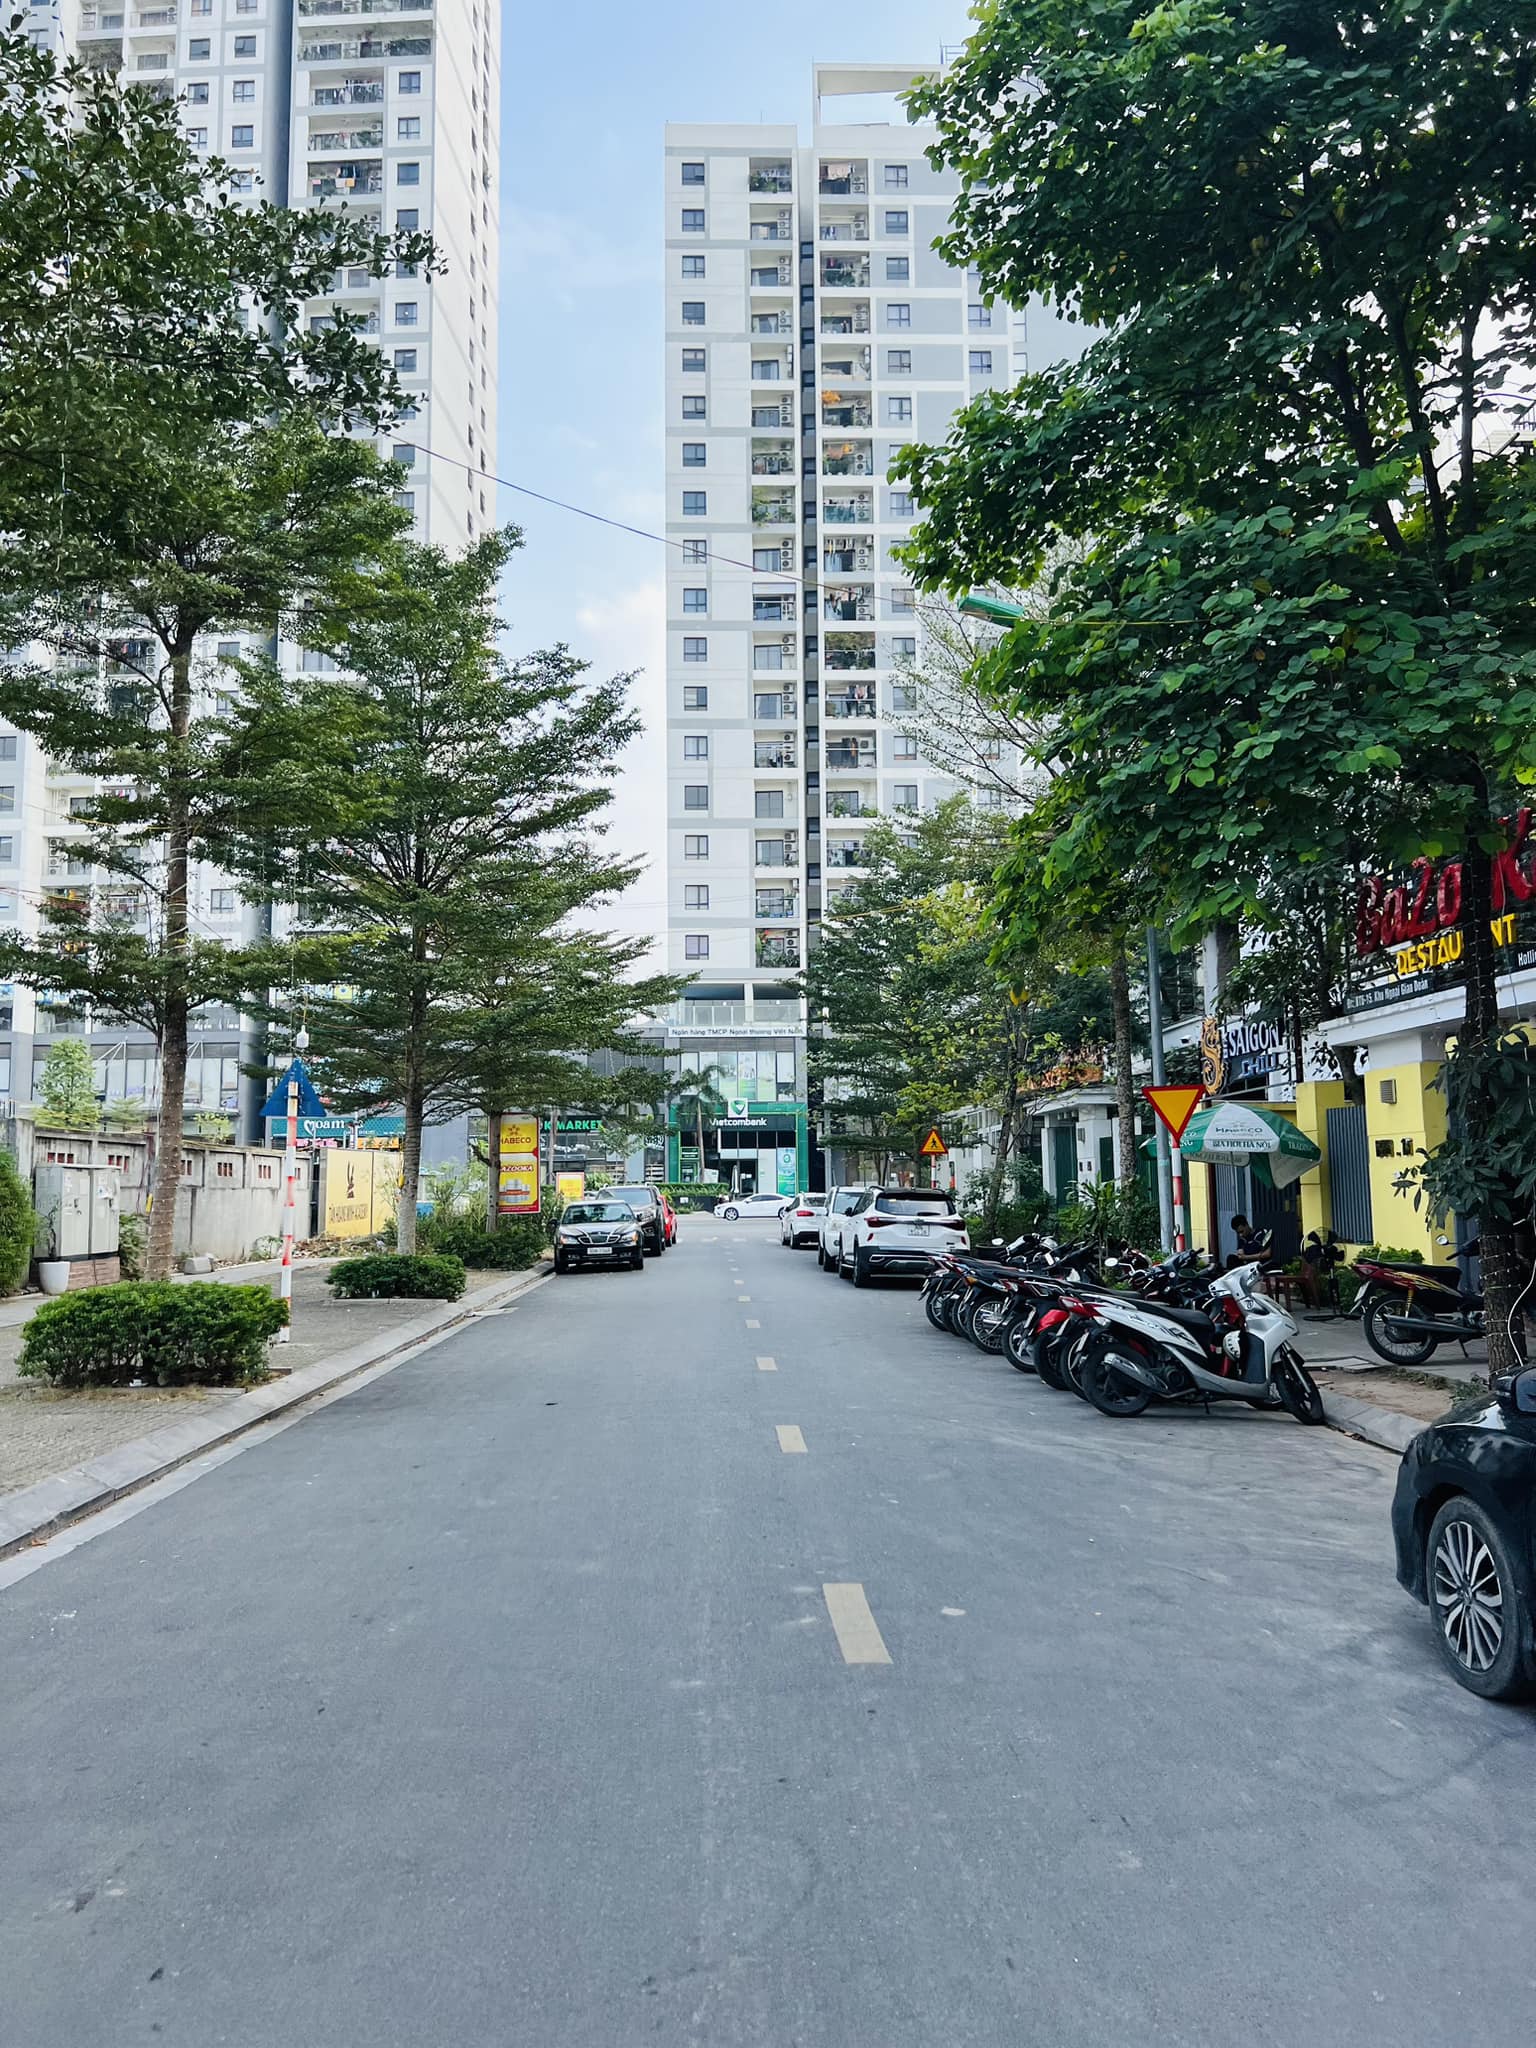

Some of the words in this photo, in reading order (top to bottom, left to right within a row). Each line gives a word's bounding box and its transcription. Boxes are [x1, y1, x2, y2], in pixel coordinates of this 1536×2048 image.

[1397, 913, 1516, 976] RESTAUNT
[1517, 948, 1536, 966] Hotli
[1228, 1019, 1279, 1057] SAIGON
[710, 1117, 767, 1126] Vietcombank
[500, 1163, 533, 1172] AZOOKA
